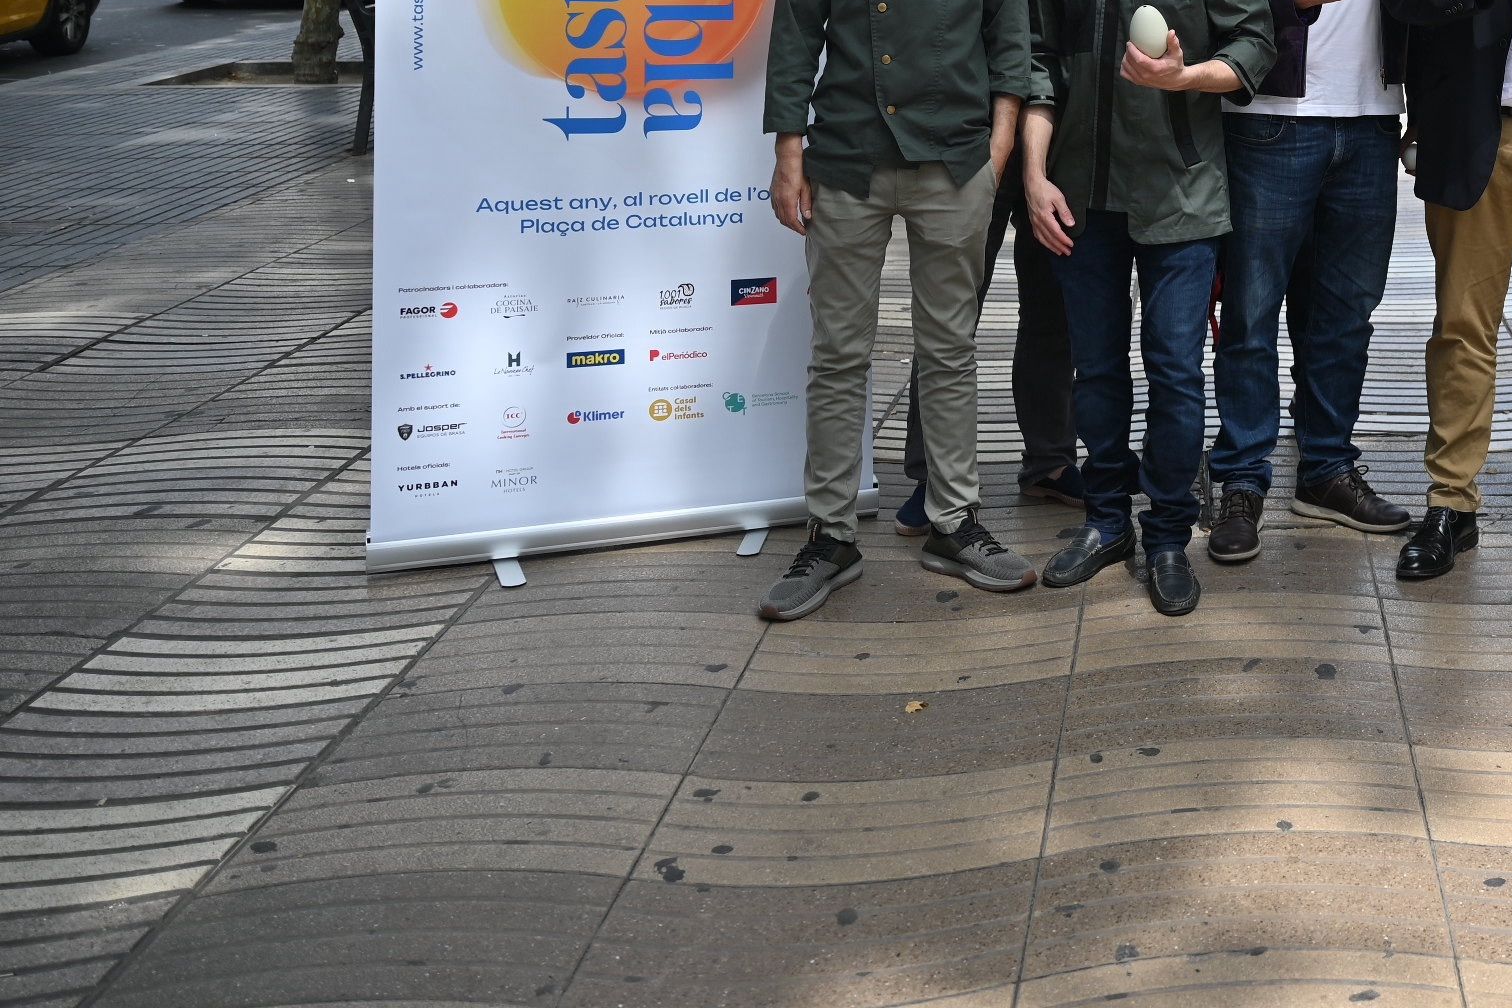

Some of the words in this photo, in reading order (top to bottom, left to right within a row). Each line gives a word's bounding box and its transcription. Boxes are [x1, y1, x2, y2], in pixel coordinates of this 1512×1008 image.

[475, 195, 564, 215] Aquest
[568, 195, 618, 213] any,
[623, 191, 643, 208] al
[648, 188, 710, 206] rovell
[714, 187, 742, 203] de
[747, 186, 772, 202] l'o
[520, 216, 586, 237] Plaça
[591, 214, 620, 232] de
[625, 210, 744, 231] Catalunya
[398, 285, 451, 294] Patrocinadors
[738, 286, 770, 295] CINZANO
[495, 298, 532, 308] COCINA
[399, 306, 436, 316] FAGOR
[490, 307, 502, 315] DE
[571, 352, 621, 366] makro
[661, 349, 708, 362] elPeriódico
[674, 396, 697, 405] Casal
[423, 403, 449, 411] suport
[674, 404, 692, 413] dels
[583, 409, 625, 423] Klimer
[417, 422, 468, 433] Josper
[396, 464, 421, 472] Hotels
[421, 462, 451, 470] oficials:
[398, 479, 459, 492] YURBBAN
[490, 475, 538, 489] MINOR
